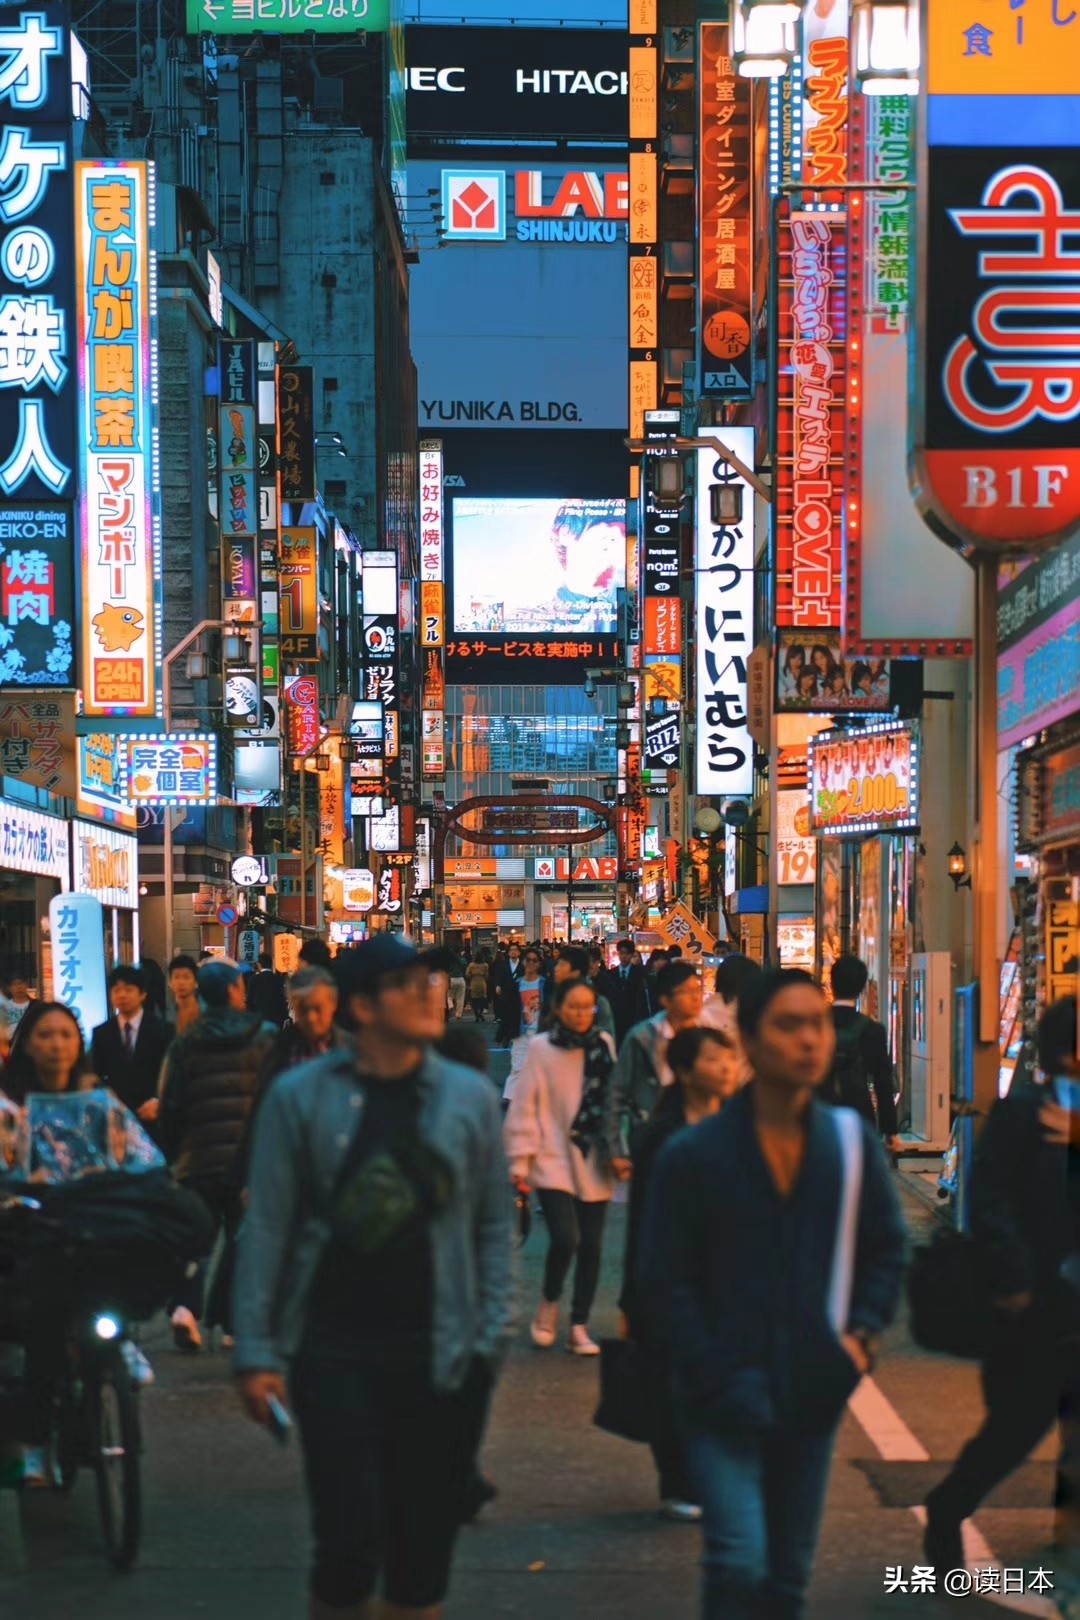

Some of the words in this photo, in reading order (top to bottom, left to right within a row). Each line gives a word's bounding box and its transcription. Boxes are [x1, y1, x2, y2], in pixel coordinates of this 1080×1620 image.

[645, 37, 653, 47] 9
[645, 143, 652, 153] 8
[516, 220, 617, 242] SHINJUKU
[645, 246, 652, 256] 7
[645, 351, 652, 361] 6
[710, 374, 737, 386] 入口
[421, 400, 514, 421] YUNIKA
[520, 401, 583, 422] BLDG.
[961, 464, 1069, 508] B1F
[422, 462, 440, 570] お好み焼き
[101, 461, 132, 595] マンボー
[793, 480, 833, 597] LOVE
[232, 545, 244, 590] ROYAL
[6, 549, 49, 625] 焼肉
[704, 449, 747, 772] とかつにいむら
[281, 638, 309, 653] 4F
[97, 661, 142, 683] 24h
[97, 683, 142, 700] OPEN
[32, 703, 60, 717] 全品
[136, 748, 181, 769] 完全
[156, 770, 201, 791] 個室
[243, 932, 256, 962] 居酒屋
